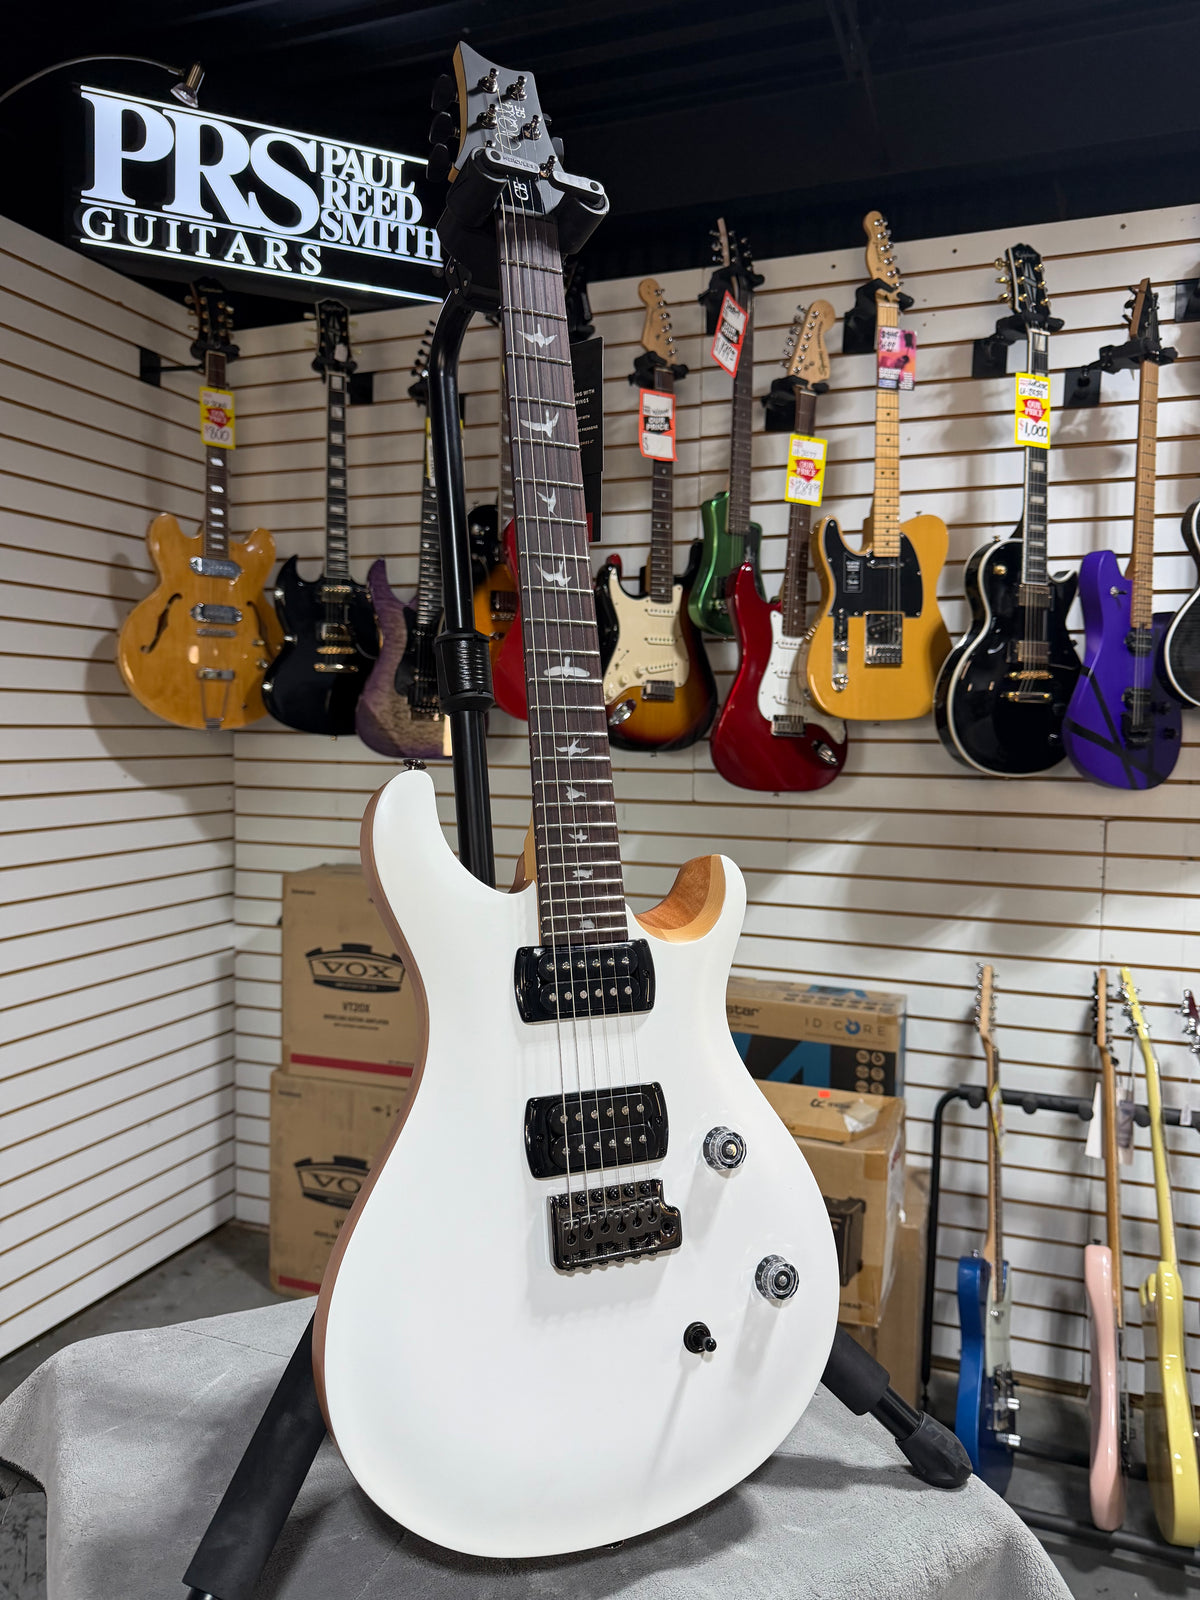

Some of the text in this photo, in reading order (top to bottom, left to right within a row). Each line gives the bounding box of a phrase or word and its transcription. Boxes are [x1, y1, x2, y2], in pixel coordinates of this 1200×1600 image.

[80, 90, 320, 236] PRS
[320, 142, 416, 194] PAUL
[321, 174, 423, 225] REED
[80, 207, 323, 277] GUITARS
[319, 208, 443, 262] SMITH
[1024, 407, 1043, 417] PRICE
[1026, 399, 1042, 409] OUR
[645, 423, 669, 431] PRICE
[319, 961, 395, 979] VOX
[311, 1173, 362, 1195] VO
